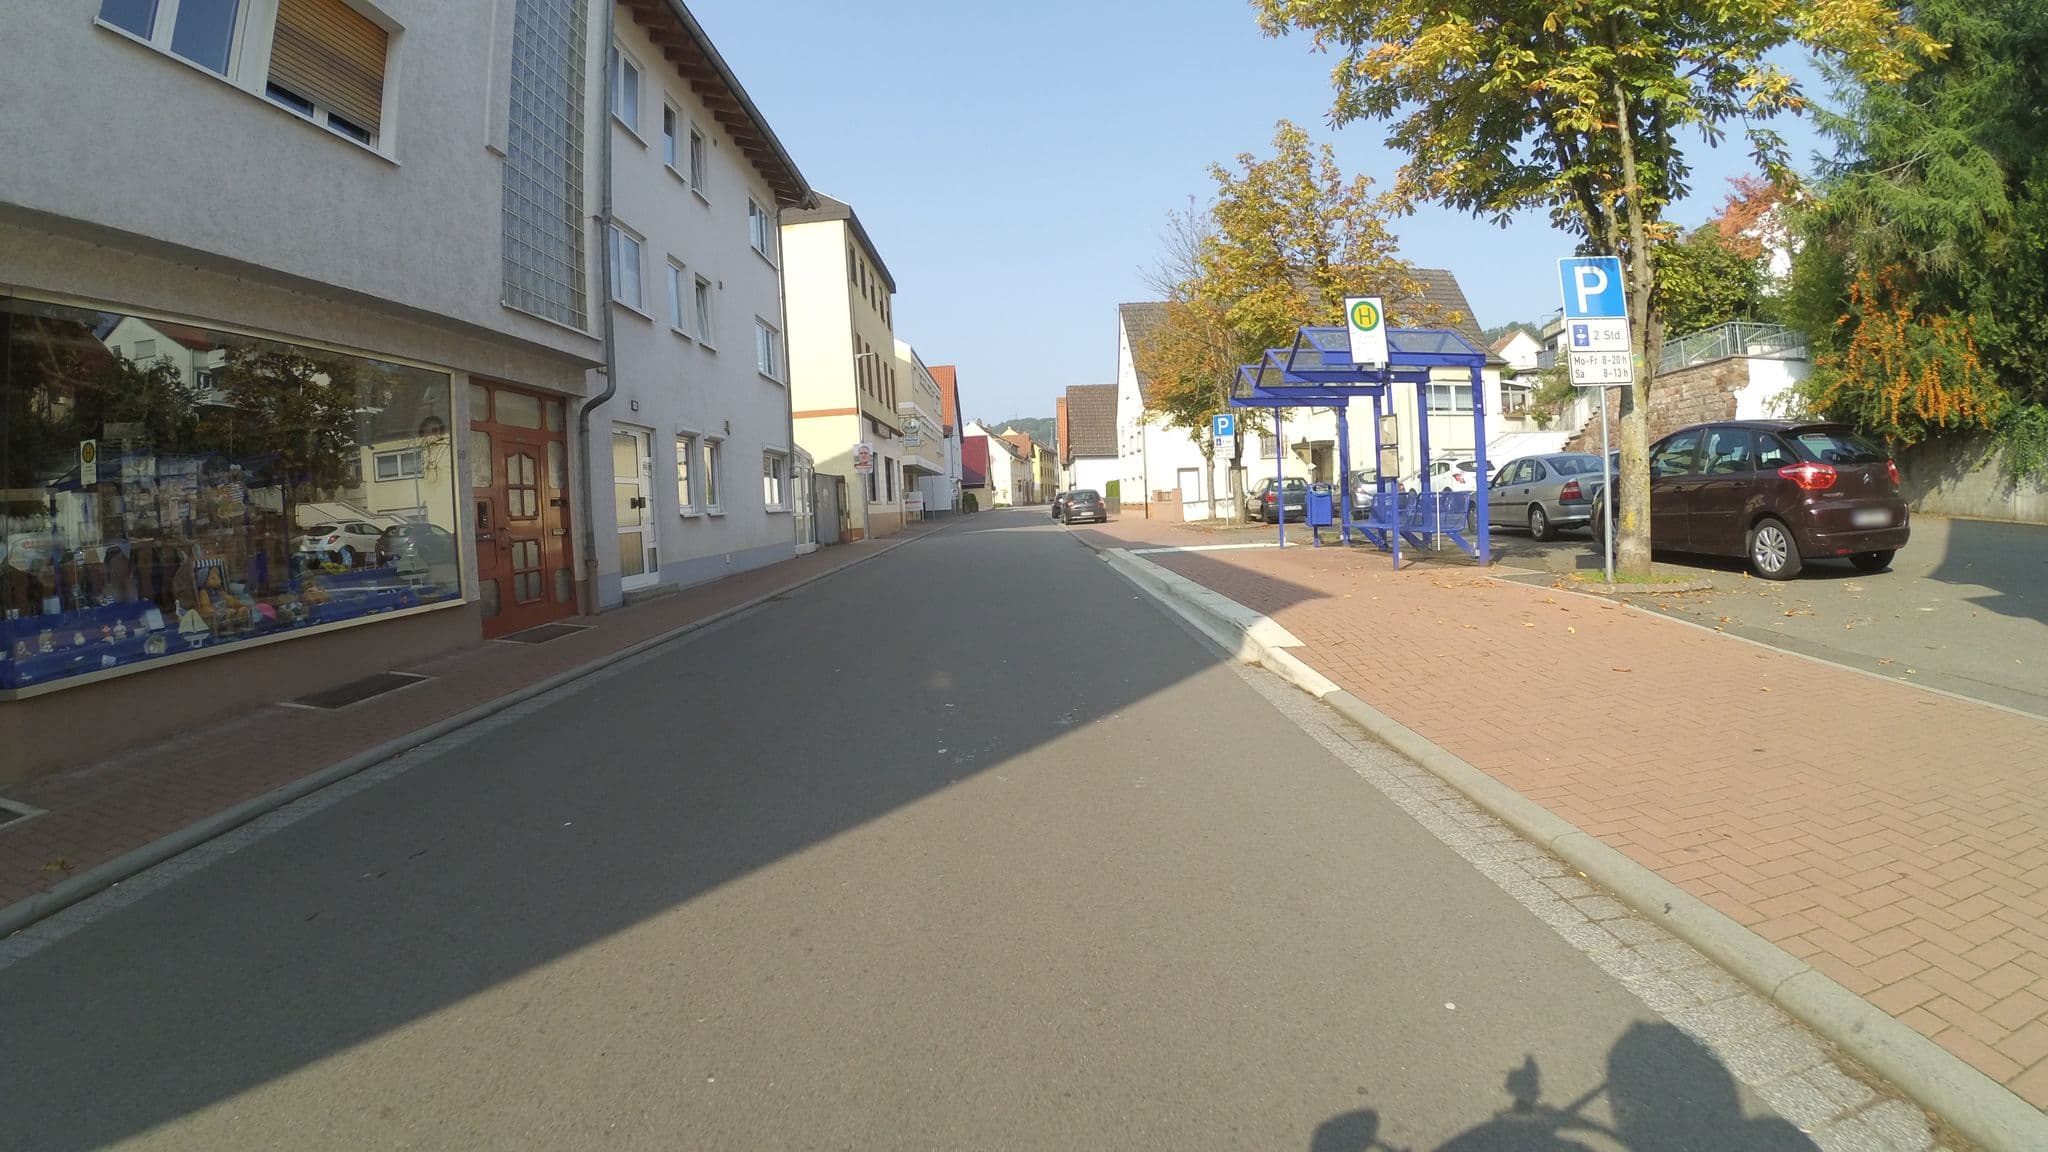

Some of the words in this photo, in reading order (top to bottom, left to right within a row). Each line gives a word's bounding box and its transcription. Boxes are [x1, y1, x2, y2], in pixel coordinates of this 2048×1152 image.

[1574, 265, 1608, 313] P
[1358, 307, 1372, 325] H
[1593, 330, 1600, 340] 2
[1603, 330, 1621, 340] Std
[1574, 355, 1598, 365] Mo-Fr
[1575, 369, 1585, 378] Sa
[1217, 417, 1229, 435] P
